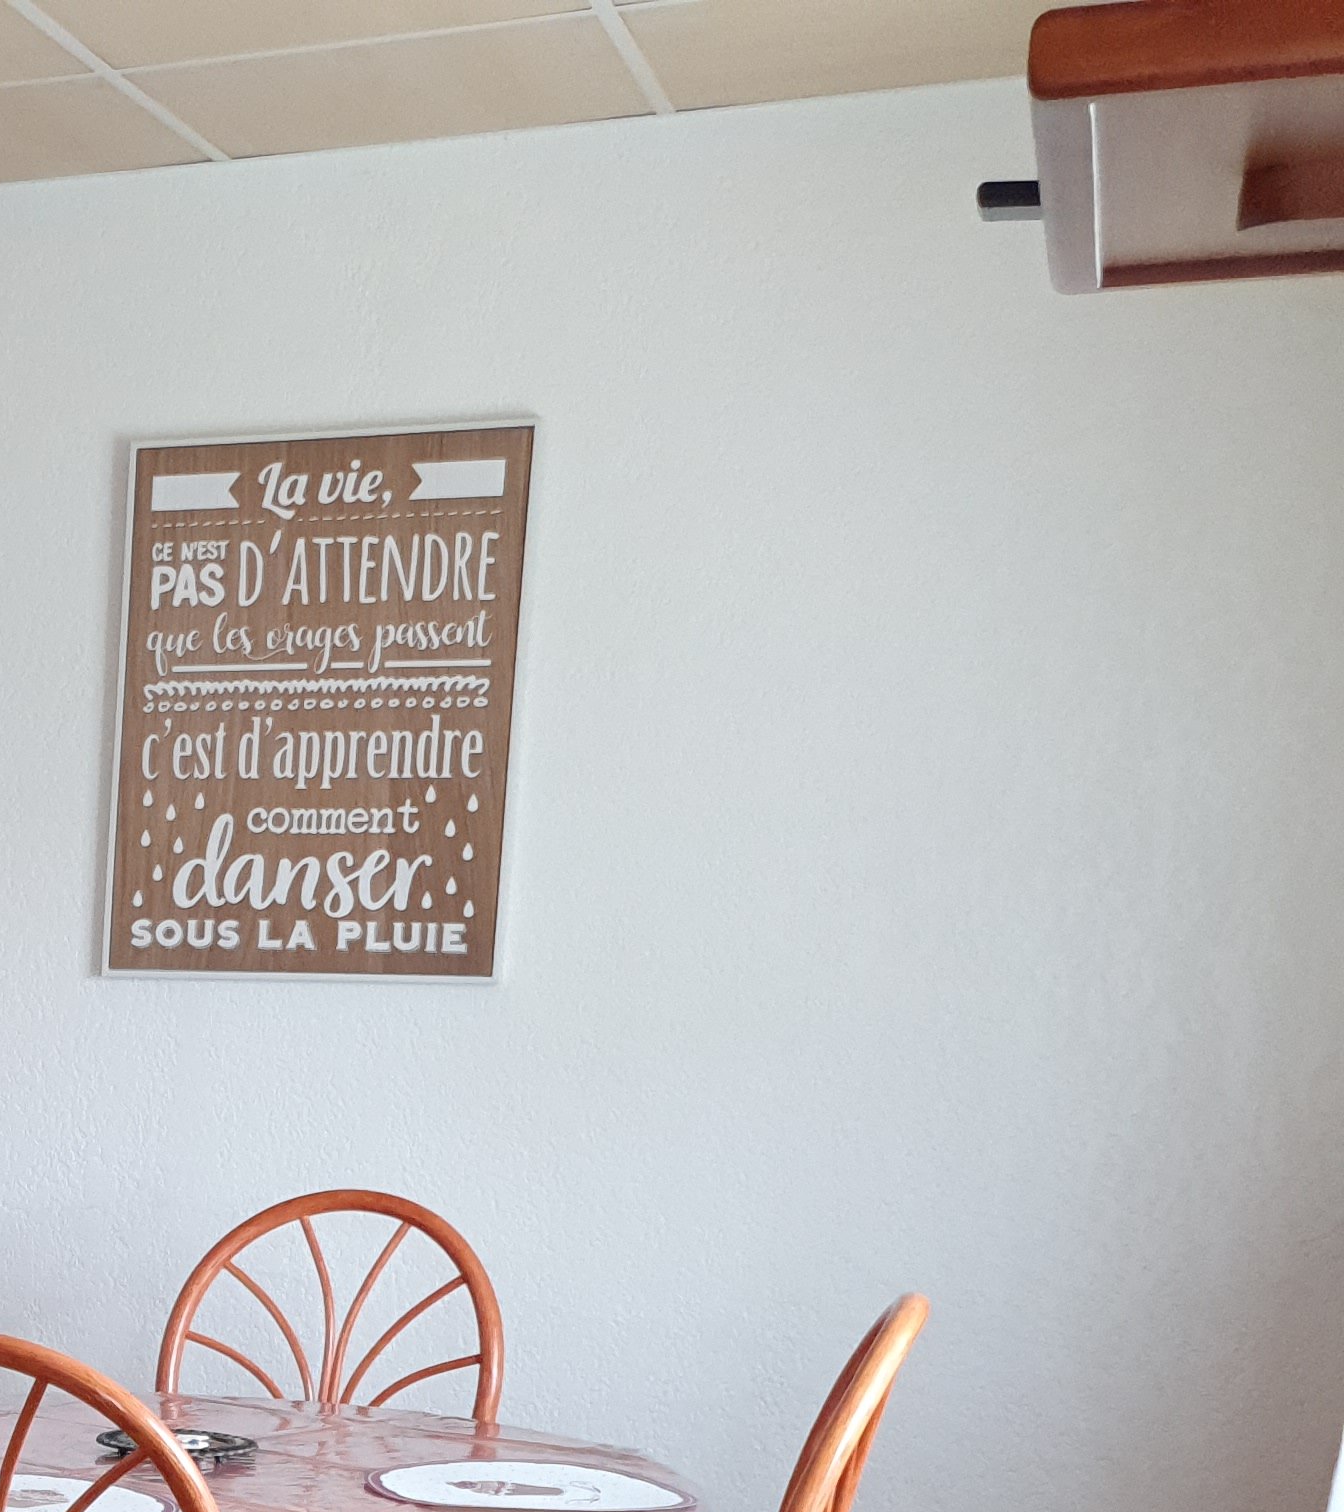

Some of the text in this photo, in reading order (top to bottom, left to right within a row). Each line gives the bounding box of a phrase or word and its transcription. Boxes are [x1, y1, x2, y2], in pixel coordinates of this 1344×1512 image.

[257, 459, 393, 519] La vie,
[151, 540, 230, 562] CE N'EST
[238, 528, 501, 607] D'ATTENDRE
[150, 563, 226, 610] PAS
[145, 608, 493, 677] que les orages passent
[141, 713, 485, 790] c'est d'apprendre
[246, 798, 421, 835] comment
[172, 812, 434, 919] danser
[130, 917, 469, 954] SOUS LA PLUIE
